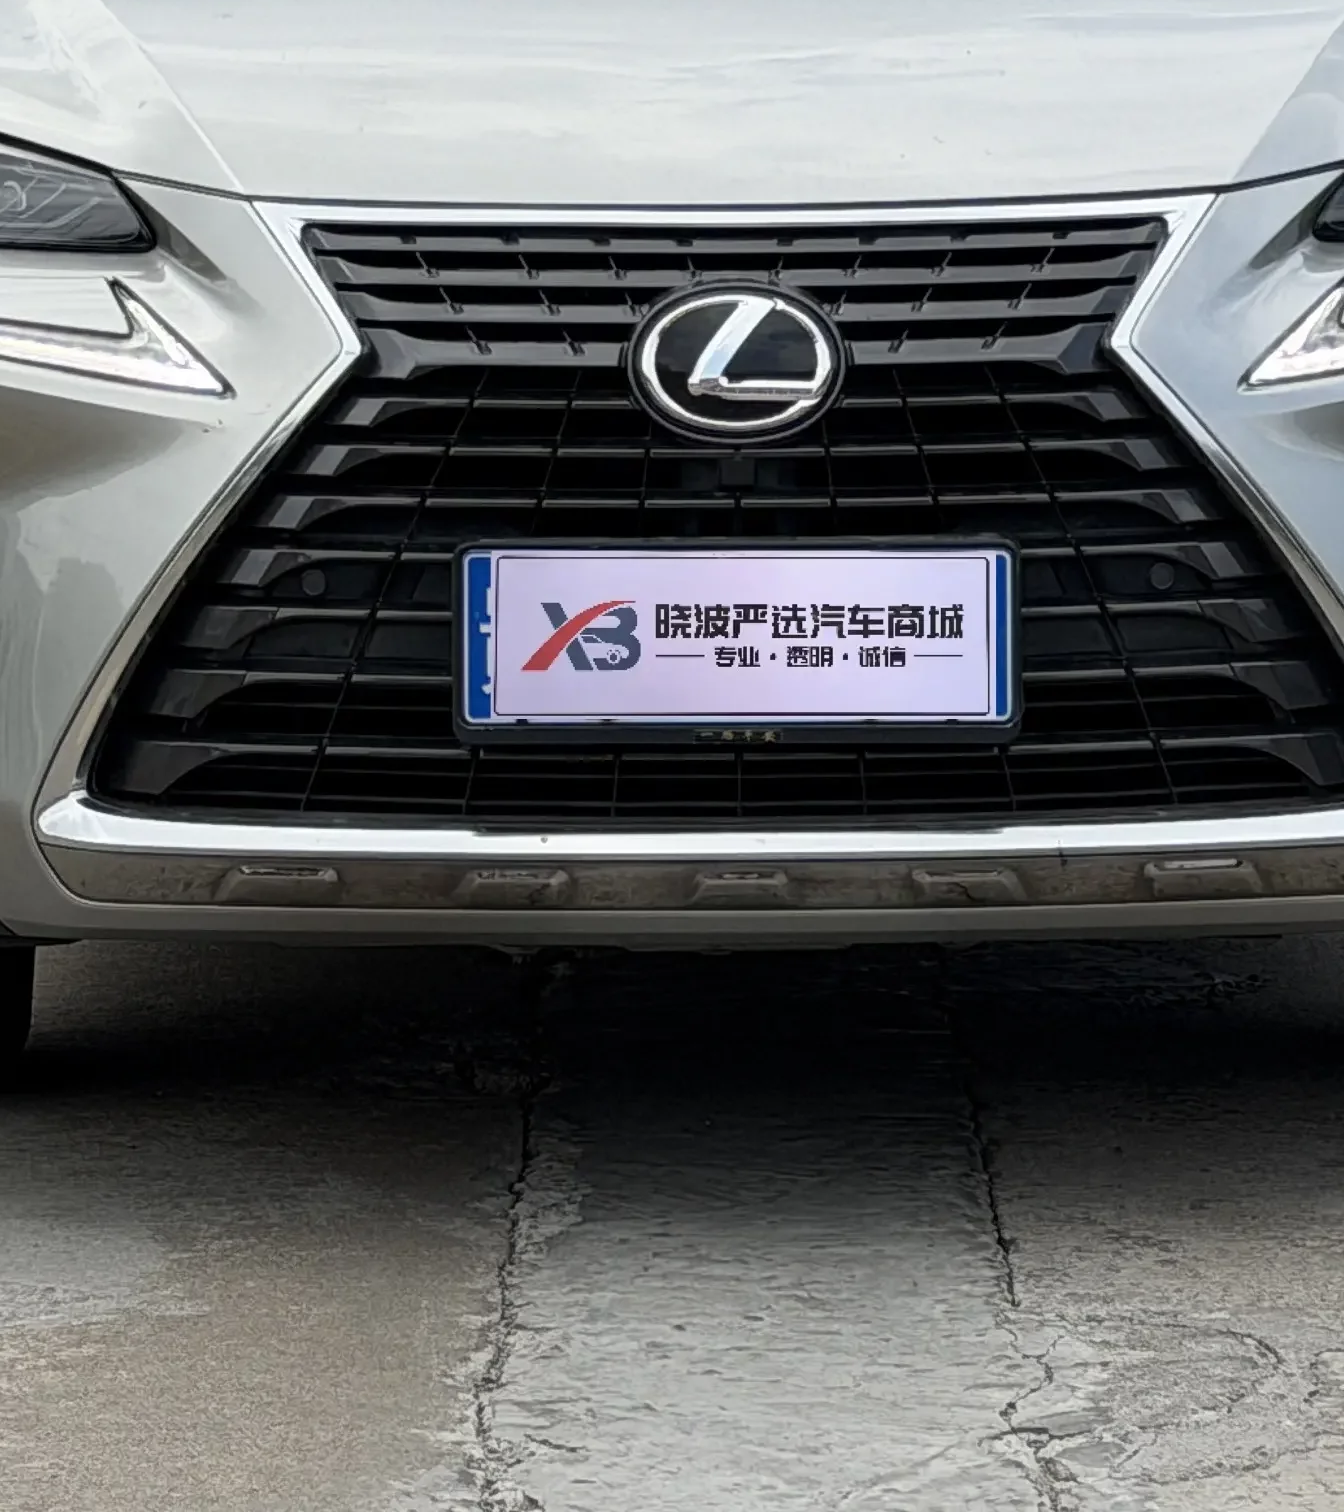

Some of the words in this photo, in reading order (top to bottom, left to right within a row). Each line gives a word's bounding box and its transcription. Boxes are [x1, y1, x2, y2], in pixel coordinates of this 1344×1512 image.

[655, 603, 964, 639] 晓波严选汽车商城
